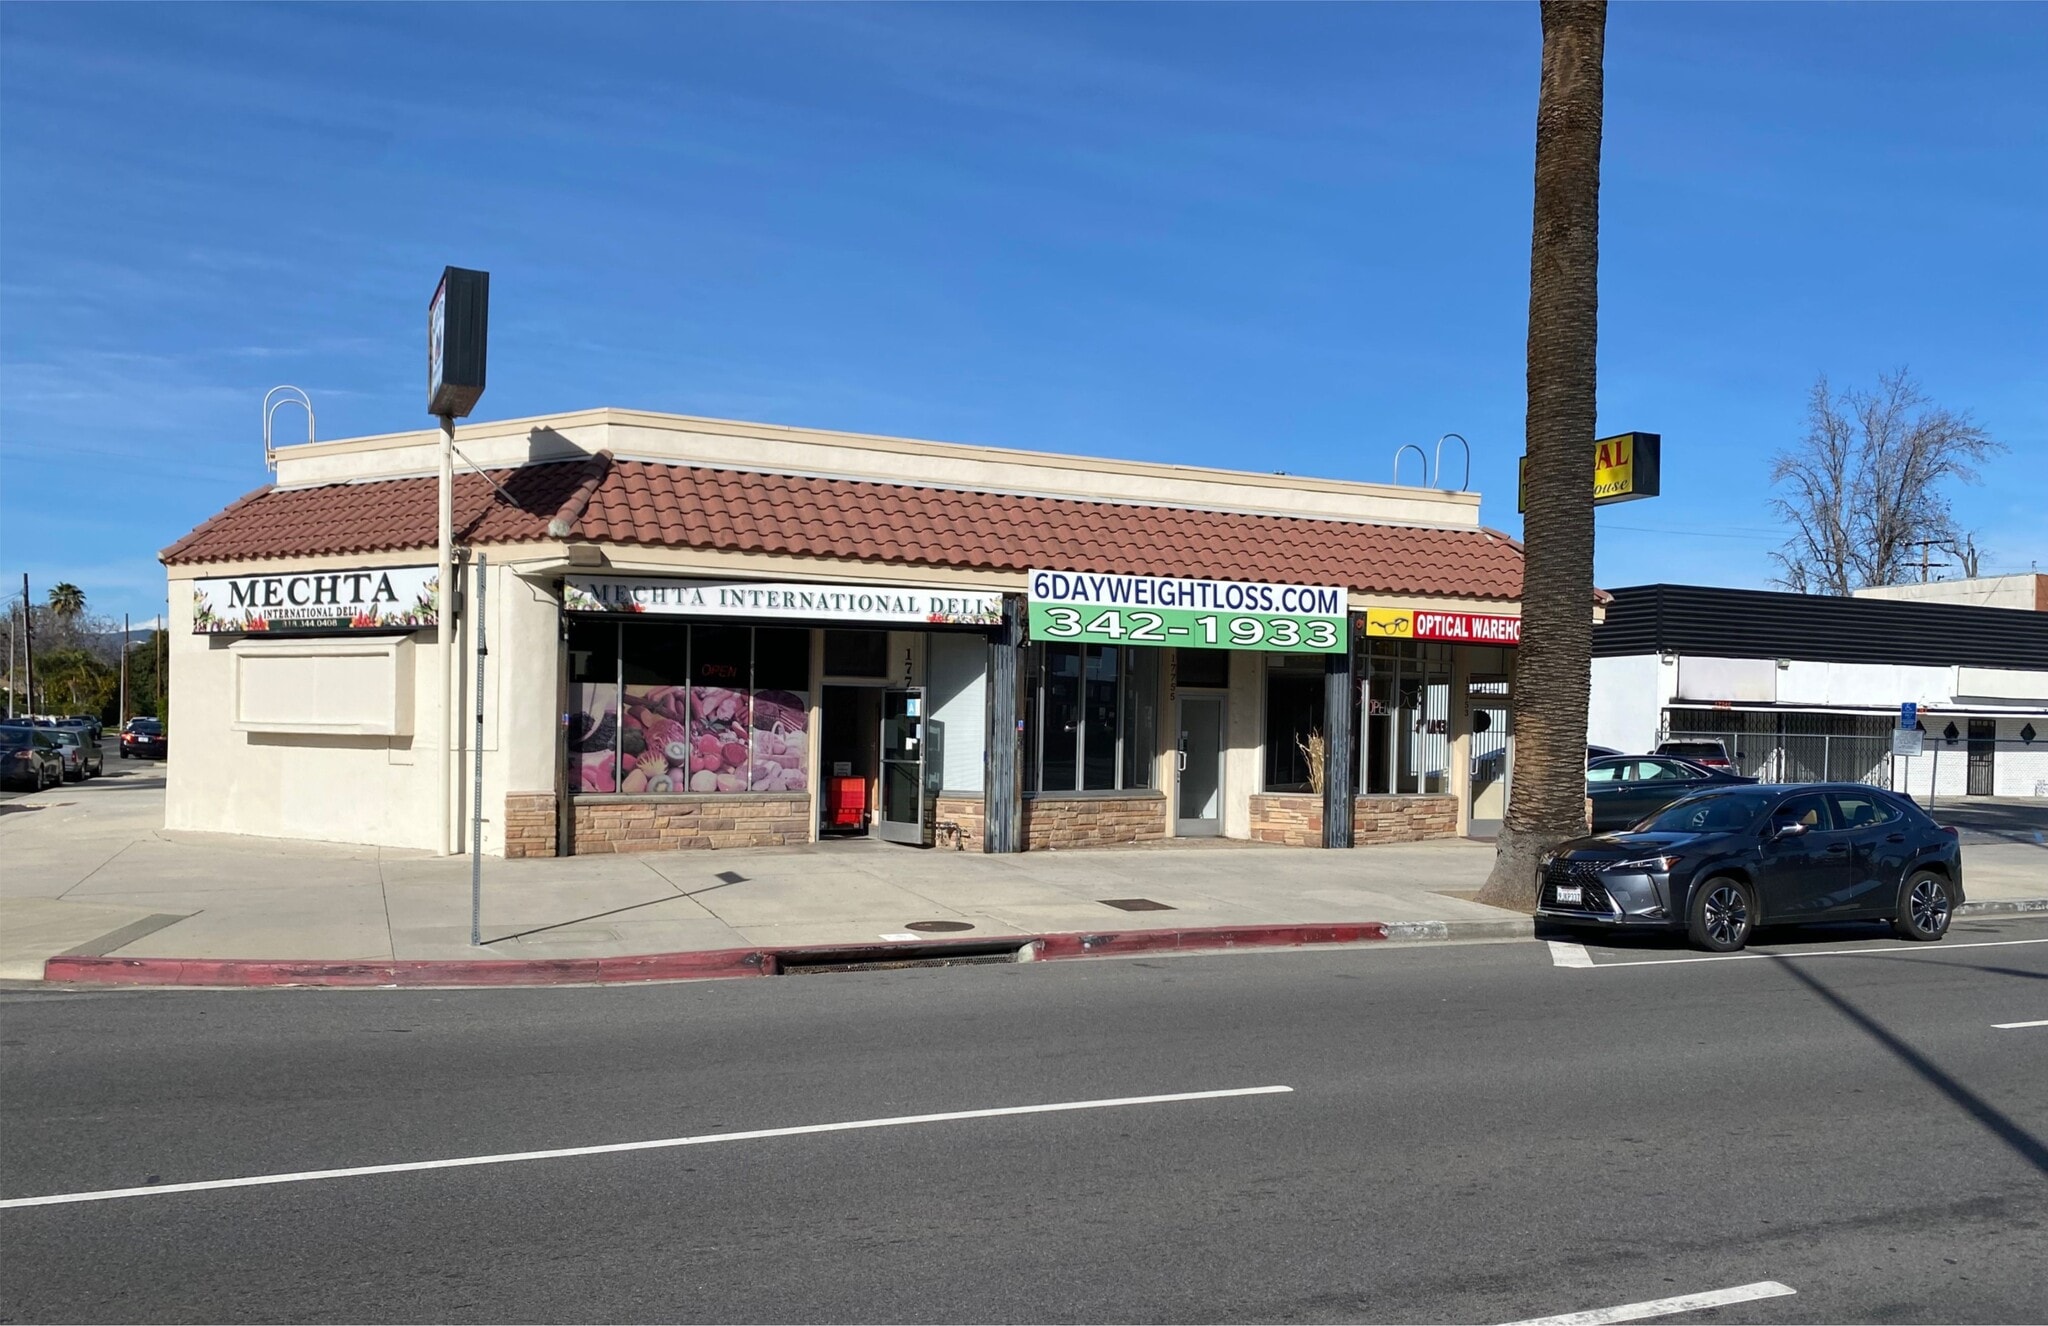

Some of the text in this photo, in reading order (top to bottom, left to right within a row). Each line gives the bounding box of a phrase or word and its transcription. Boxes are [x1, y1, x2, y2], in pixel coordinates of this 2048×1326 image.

[1596, 441, 1629, 470] AL
[1595, 479, 1628, 495] ouse
[228, 571, 399, 608] MECHTA
[589, 583, 984, 615] MECHTA INTERNATIONAL DELI
[1034, 572, 1338, 614] 6DAYWEIGHTLOSS.COM
[263, 606, 358, 619] INTERNATIONAL DELI
[1044, 607, 1338, 647] 342-1933
[1416, 614, 1520, 640] OPTICAL WAREHO
